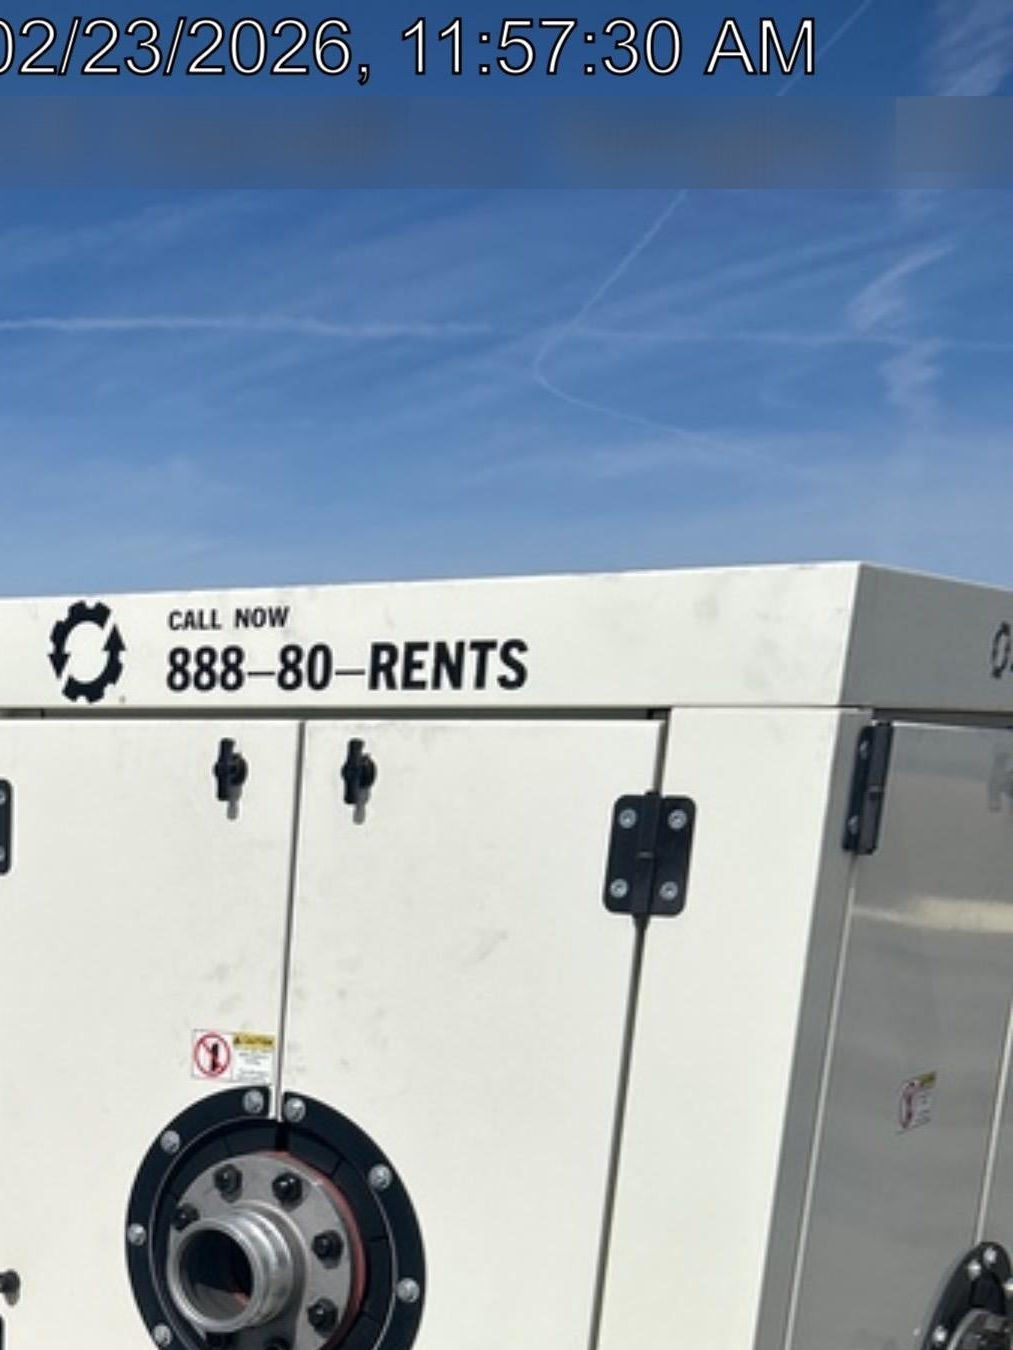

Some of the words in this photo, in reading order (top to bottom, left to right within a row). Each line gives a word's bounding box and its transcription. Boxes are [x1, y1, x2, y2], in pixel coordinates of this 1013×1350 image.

[168, 608, 221, 631] CALL
[234, 605, 290, 629] NOW
[167, 639, 529, 691] 888-80-RENTS
